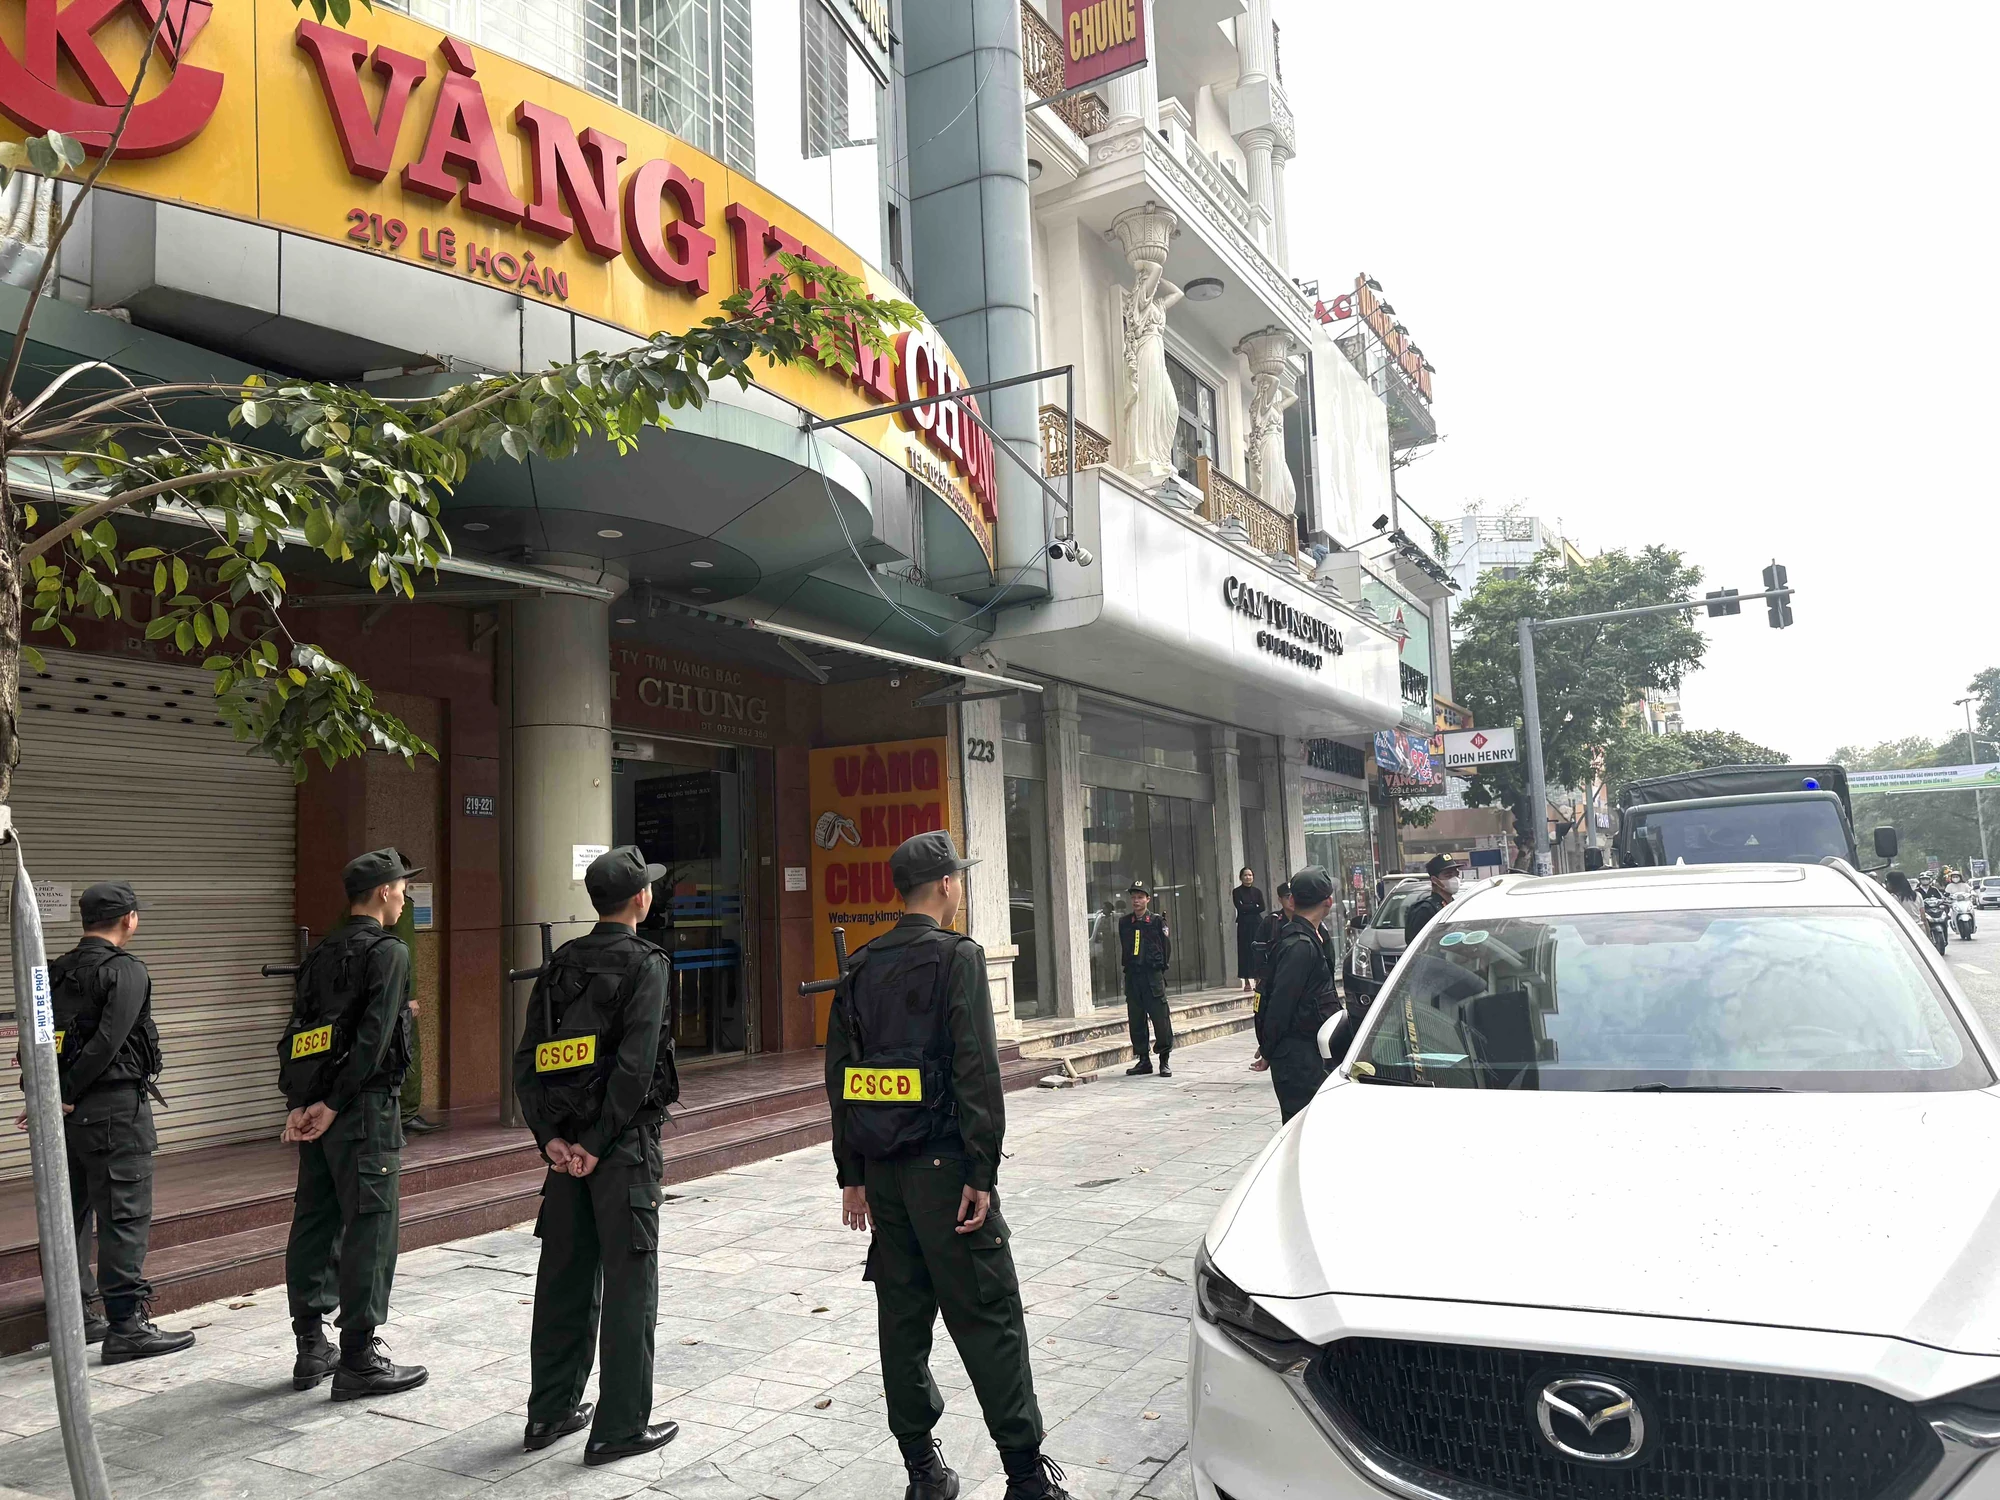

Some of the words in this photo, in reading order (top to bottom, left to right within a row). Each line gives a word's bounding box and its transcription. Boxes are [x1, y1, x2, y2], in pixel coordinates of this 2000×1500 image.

[1068, 0, 1137, 62] CHUNG
[295, 18, 717, 298] VÀNG
[347, 207, 409, 250] 219
[419, 226, 457, 267] LÊ
[467, 241, 569, 301] HOÀN
[618, 648, 640, 666] TY
[644, 653, 668, 672] TM
[638, 676, 770, 725] CHUNG
[967, 737, 995, 763] 223
[1447, 752, 1475, 765] JOHN
[1477, 748, 1515, 762] HENRY
[833, 745, 940, 798] VÀNG
[466, 797, 493, 811] 219-221
[860, 802, 942, 848] KIM
[295, 1031, 328, 1054] CSCĐ
[540, 1042, 589, 1067] CSCĐ
[850, 1073, 911, 1096] CSCĐ
